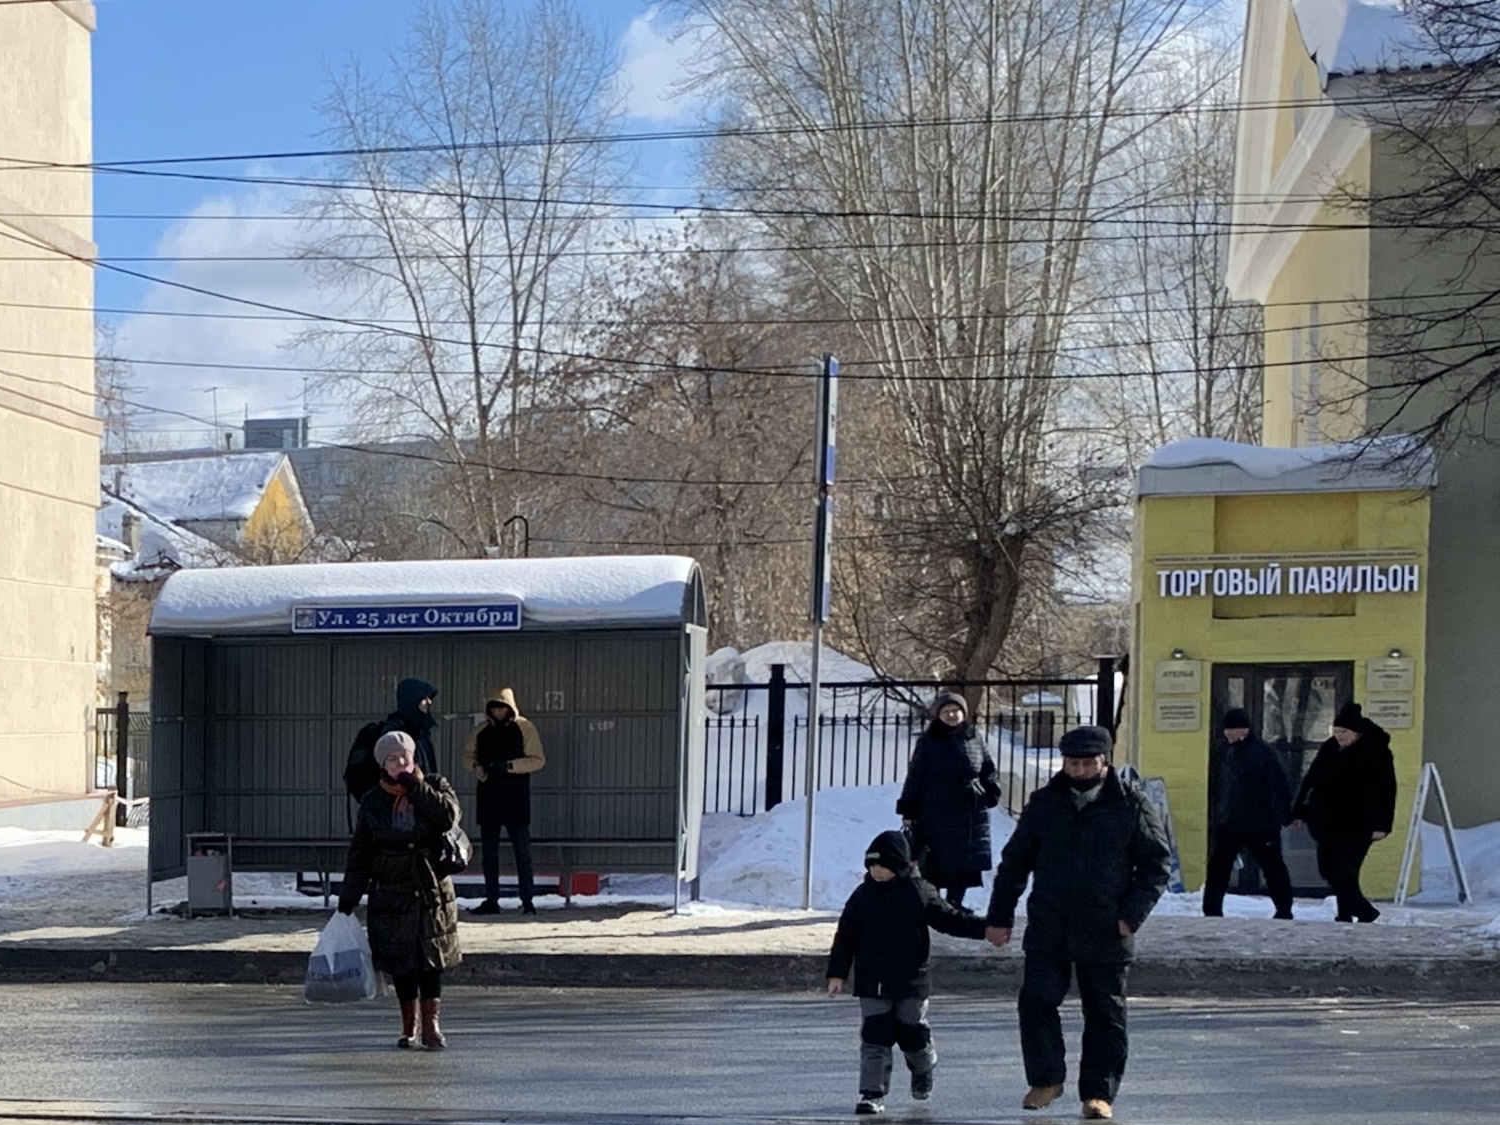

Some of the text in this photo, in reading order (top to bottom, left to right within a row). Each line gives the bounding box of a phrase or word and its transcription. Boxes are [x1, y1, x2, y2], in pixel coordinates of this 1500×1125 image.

[1157, 563, 1419, 598] ТОРГОВЫЙ ПАВИЛЬОН
[318, 608, 514, 627] Ул. 25 лет Октября
